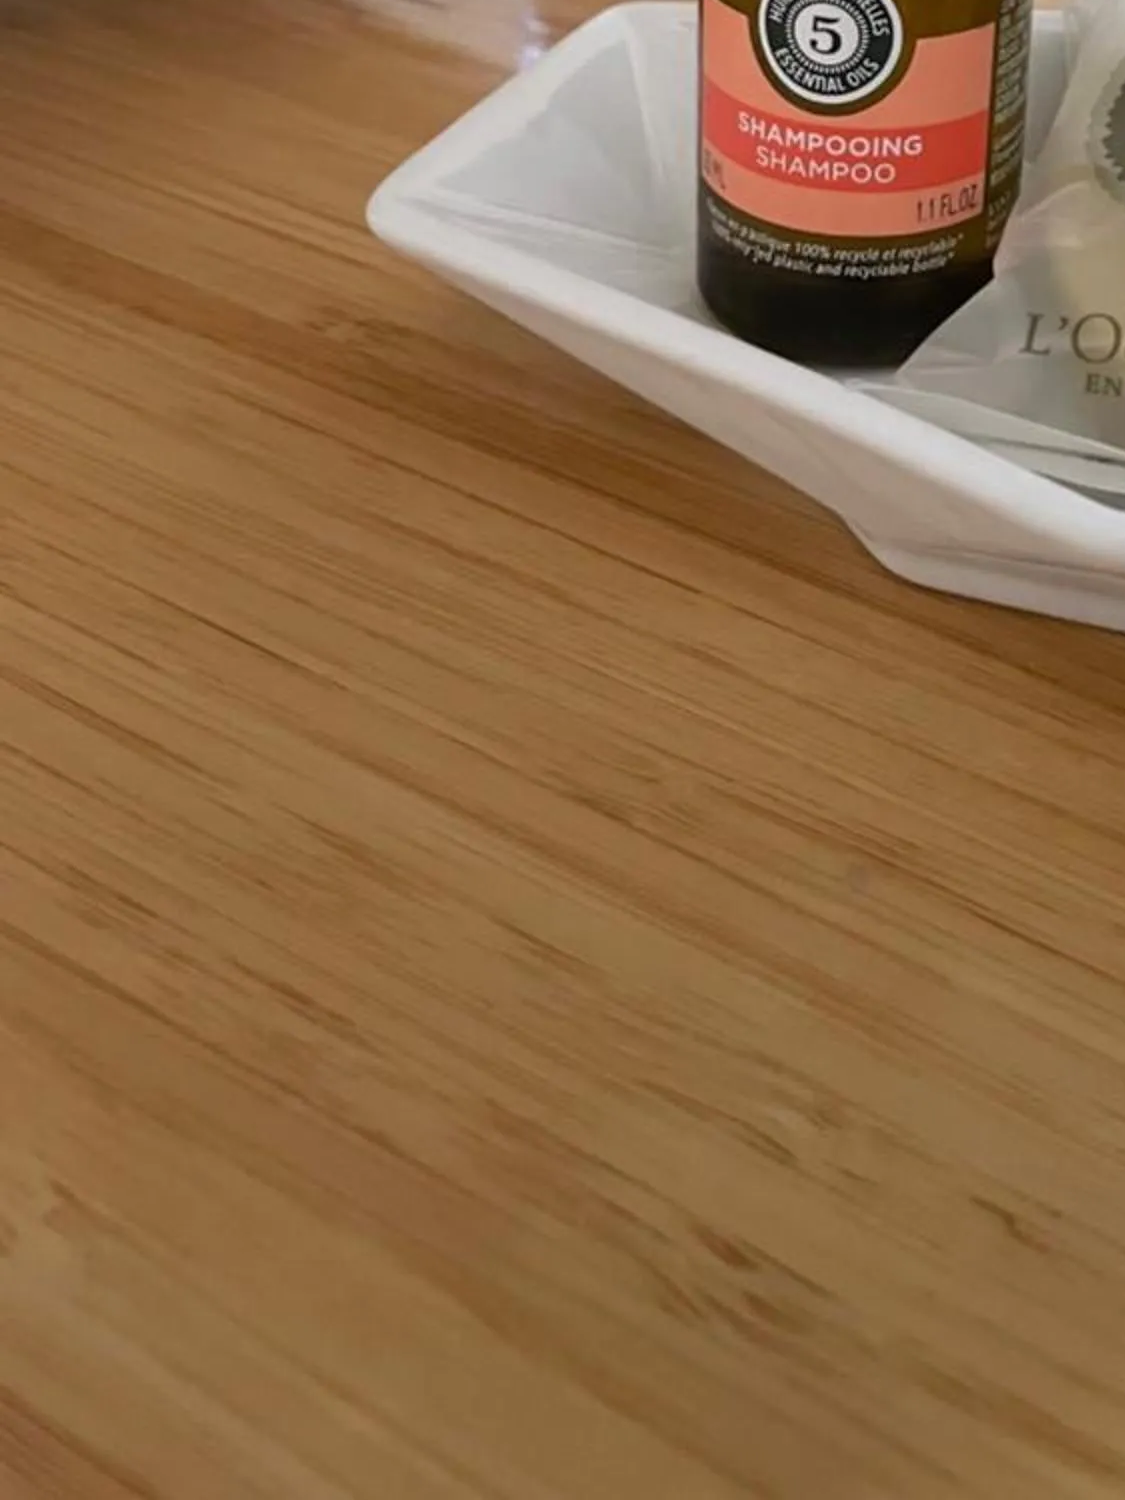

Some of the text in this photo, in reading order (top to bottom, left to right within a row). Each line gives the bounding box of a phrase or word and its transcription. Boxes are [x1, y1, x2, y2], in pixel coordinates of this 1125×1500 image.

[808, 14, 842, 56] 5
[775, 47, 880, 93] ESSENTIAL OILS
[737, 111, 924, 157] SHAMPOOING
[755, 146, 896, 184] SHAMPOO
[1085, 372, 1124, 398] EN
